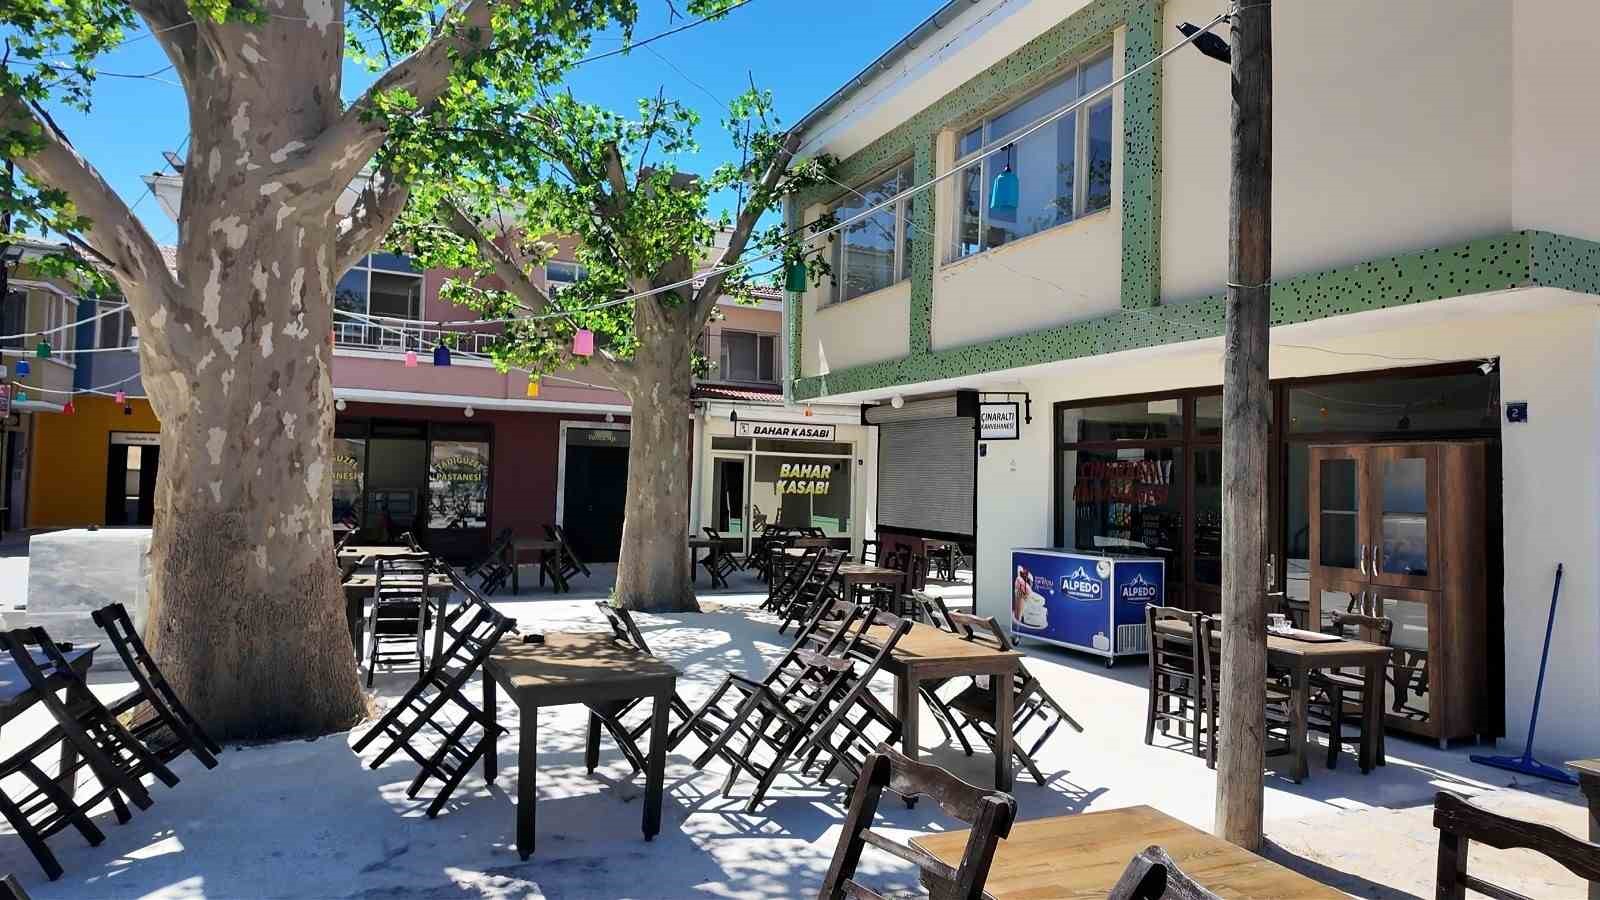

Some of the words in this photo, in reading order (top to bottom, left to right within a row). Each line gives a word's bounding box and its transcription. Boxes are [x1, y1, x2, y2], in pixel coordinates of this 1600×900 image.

[1512, 408, 1519, 417] 2
[753, 426, 789, 436] BAHAR
[791, 429, 830, 438] KASABI
[780, 463, 832, 479] BAHAR
[775, 480, 830, 495] KASABI
[1062, 579, 1100, 594] ALPEDO
[1122, 586, 1156, 597] ALPEDO
